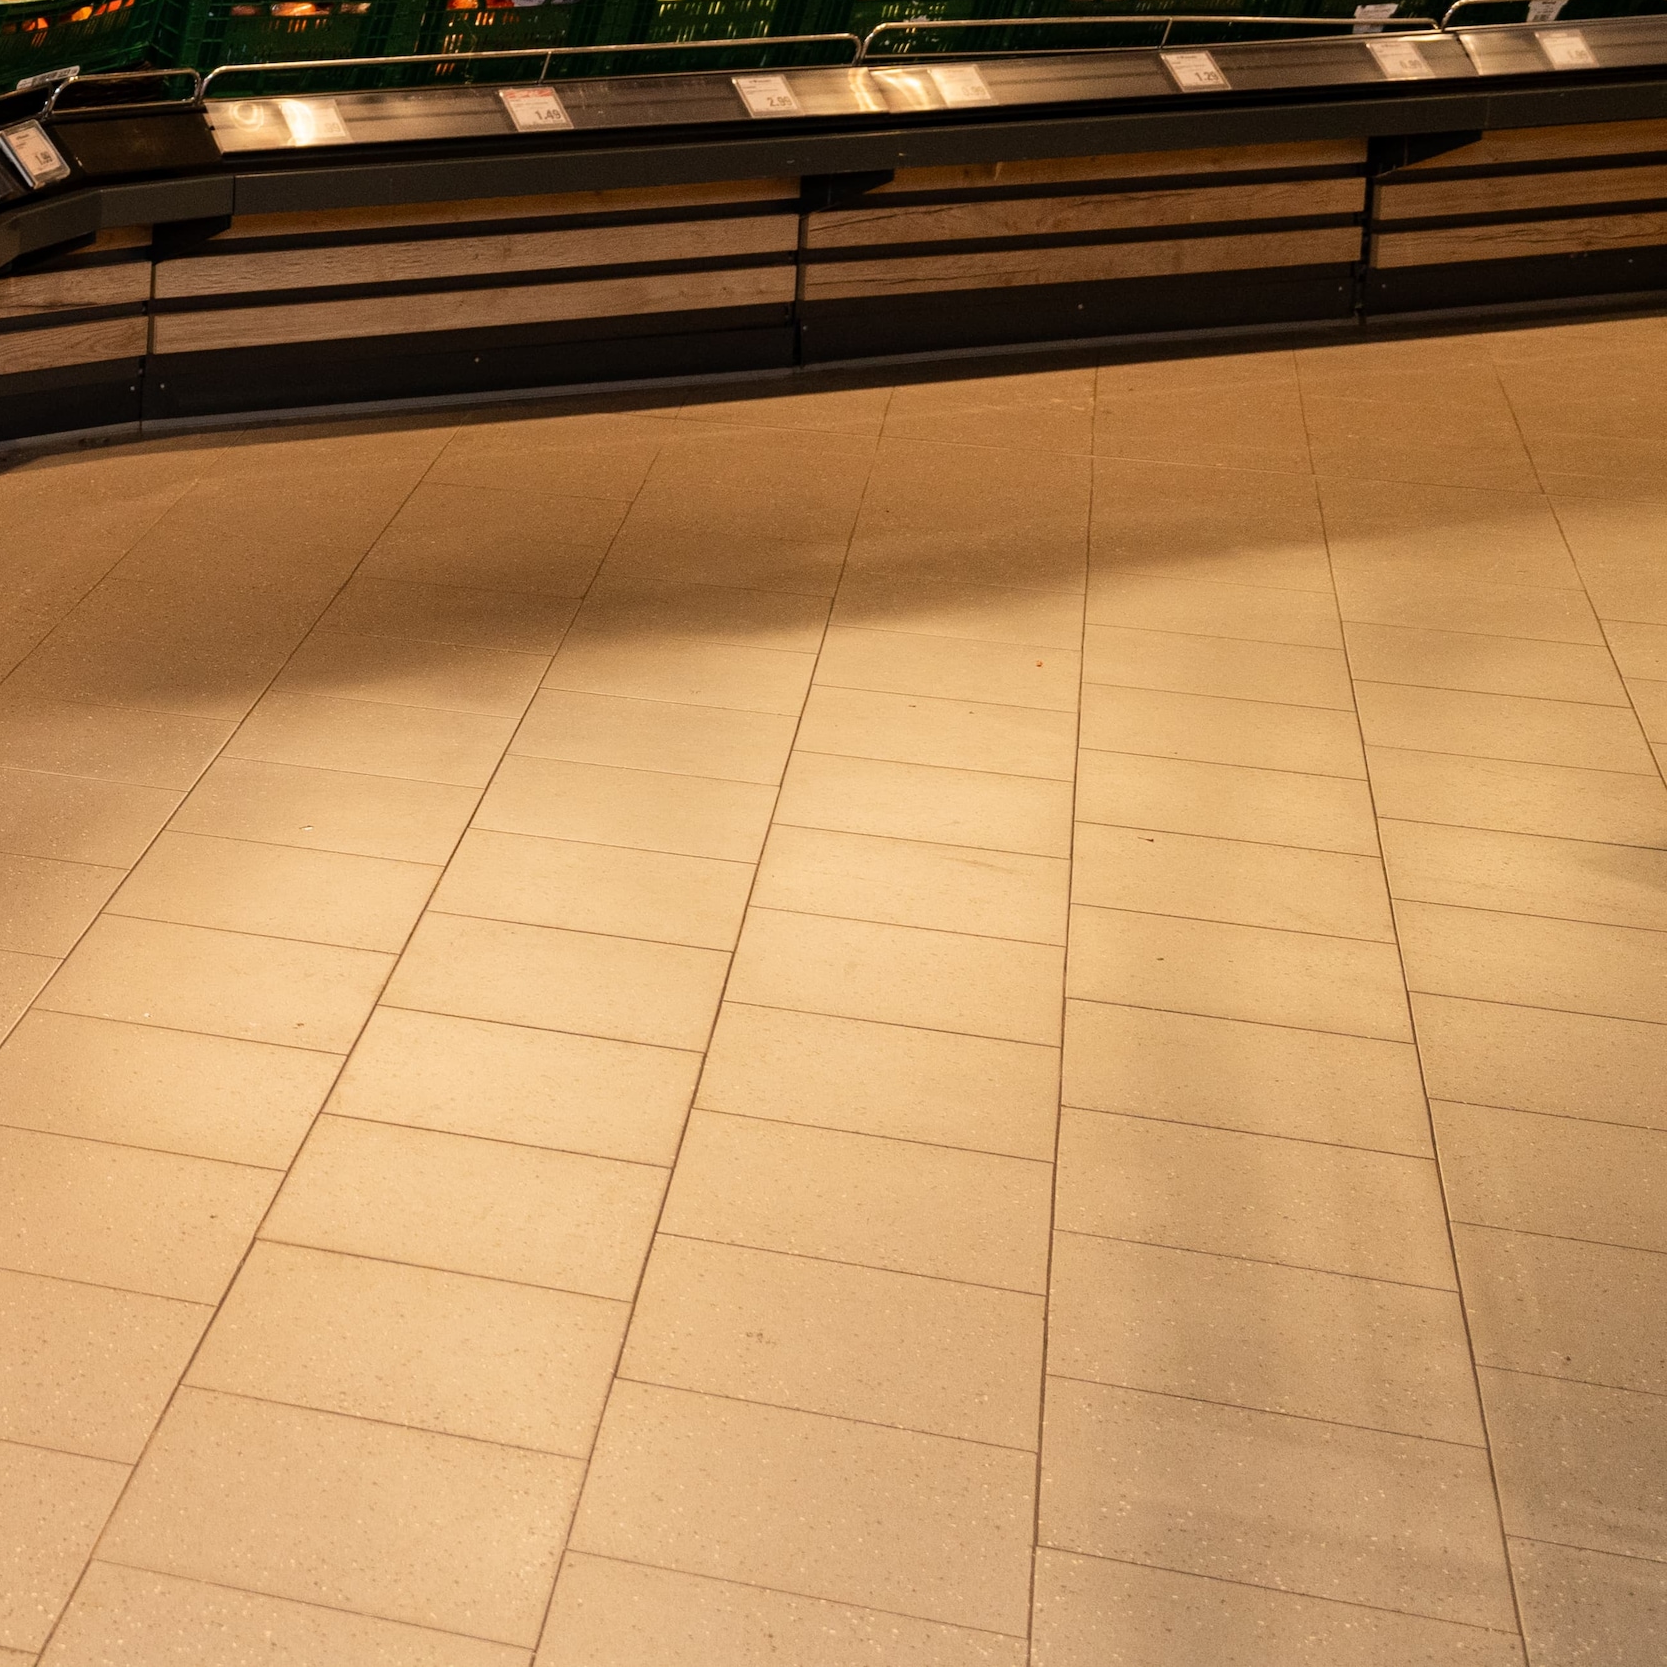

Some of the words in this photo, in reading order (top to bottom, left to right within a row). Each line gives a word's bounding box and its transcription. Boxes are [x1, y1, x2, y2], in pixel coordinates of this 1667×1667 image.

[1195, 71, 1219, 82] 1.29
[767, 96, 792, 107] 2.99
[535, 108, 561, 121] 1.49
